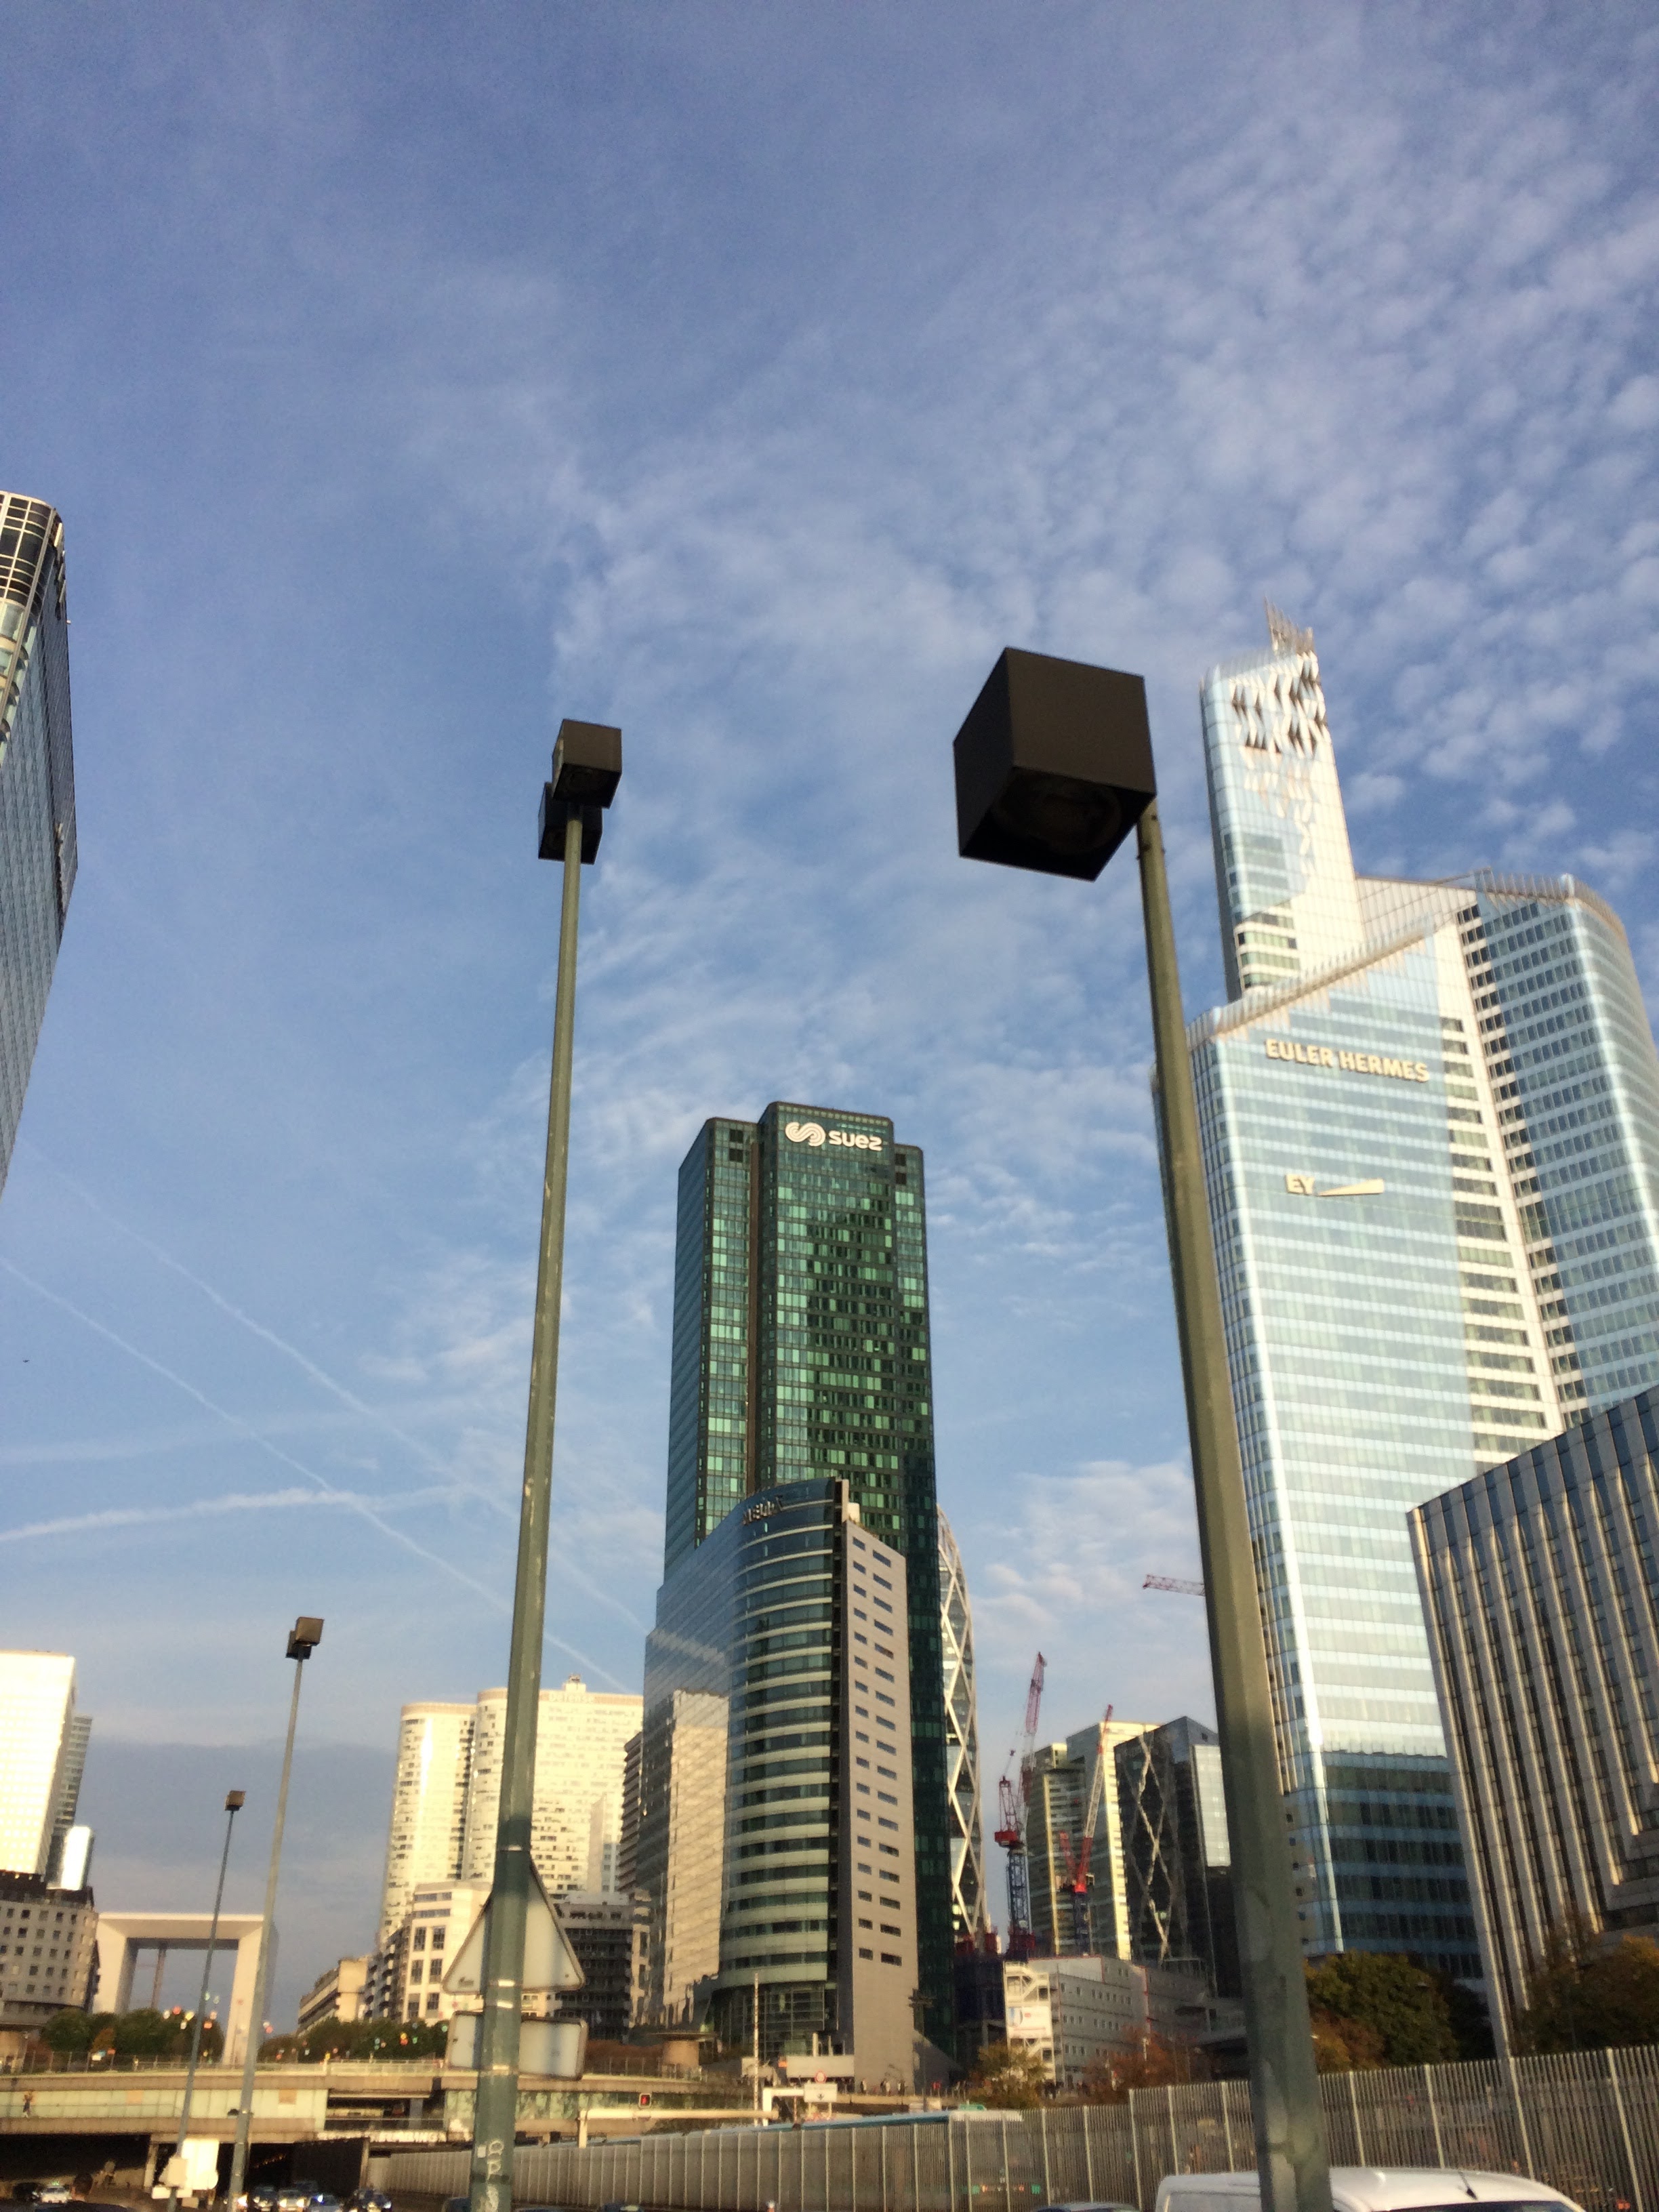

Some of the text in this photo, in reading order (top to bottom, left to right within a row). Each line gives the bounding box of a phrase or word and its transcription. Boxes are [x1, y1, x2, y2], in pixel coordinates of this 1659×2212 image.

[1264, 1038, 1430, 1082] EULER HERMES
[1285, 1173, 1315, 1195] EY
